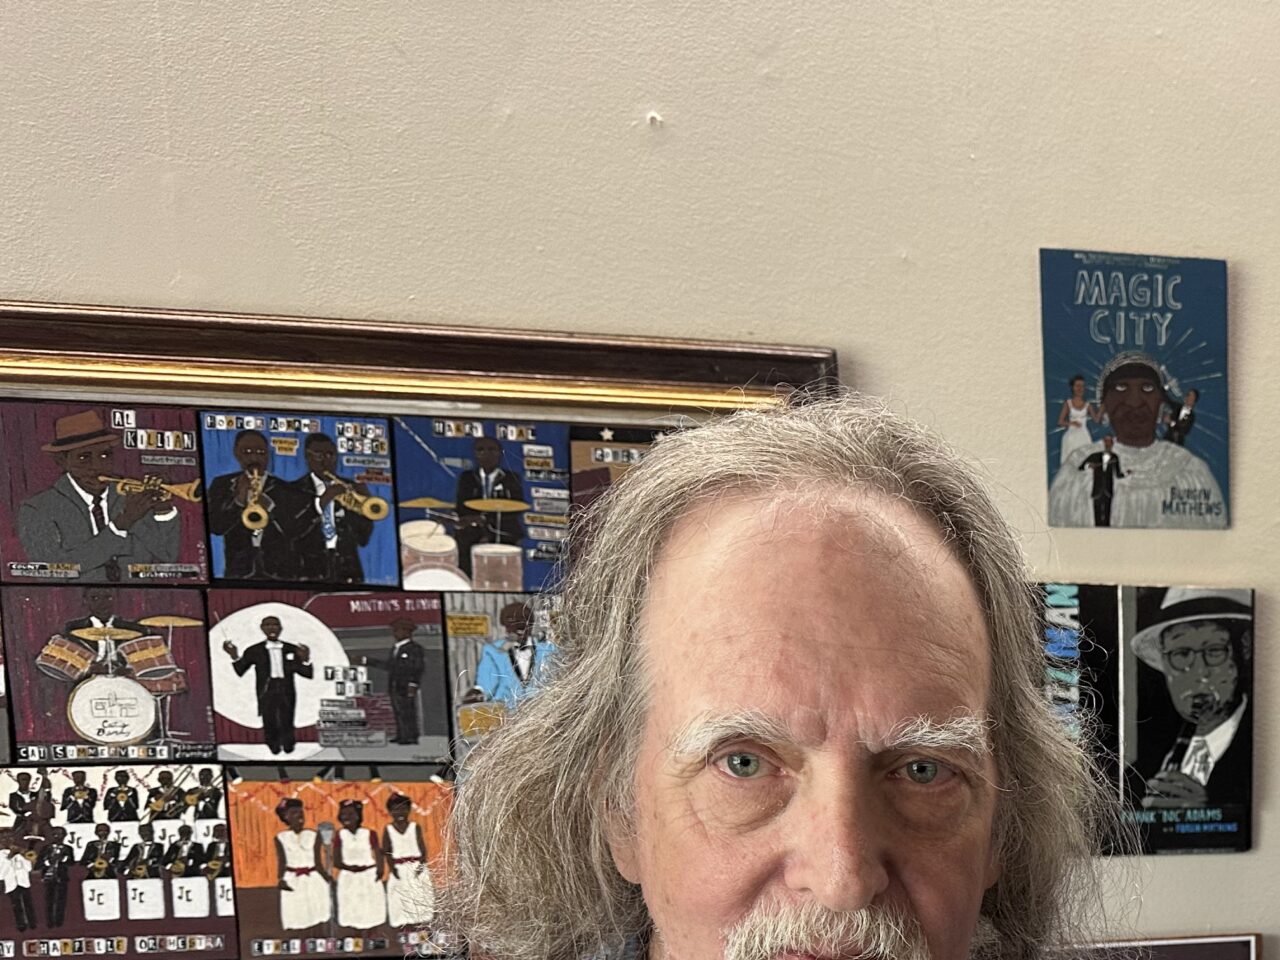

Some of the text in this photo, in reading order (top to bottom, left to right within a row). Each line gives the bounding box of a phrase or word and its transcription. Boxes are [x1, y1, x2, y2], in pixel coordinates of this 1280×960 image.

[1074, 270, 1183, 309] MAGIC
[1089, 309, 1176, 346] CITY
[113, 410, 135, 427] AL
[126, 431, 194, 449] KILLIAN
[1162, 499, 1222, 517] MATHEWS
[1044, 584, 1080, 658] MAN
[20, 746, 46, 760] CAT
[26, 938, 126, 955] CHAPPELLE
[137, 936, 223, 953] ORCHESTRA
